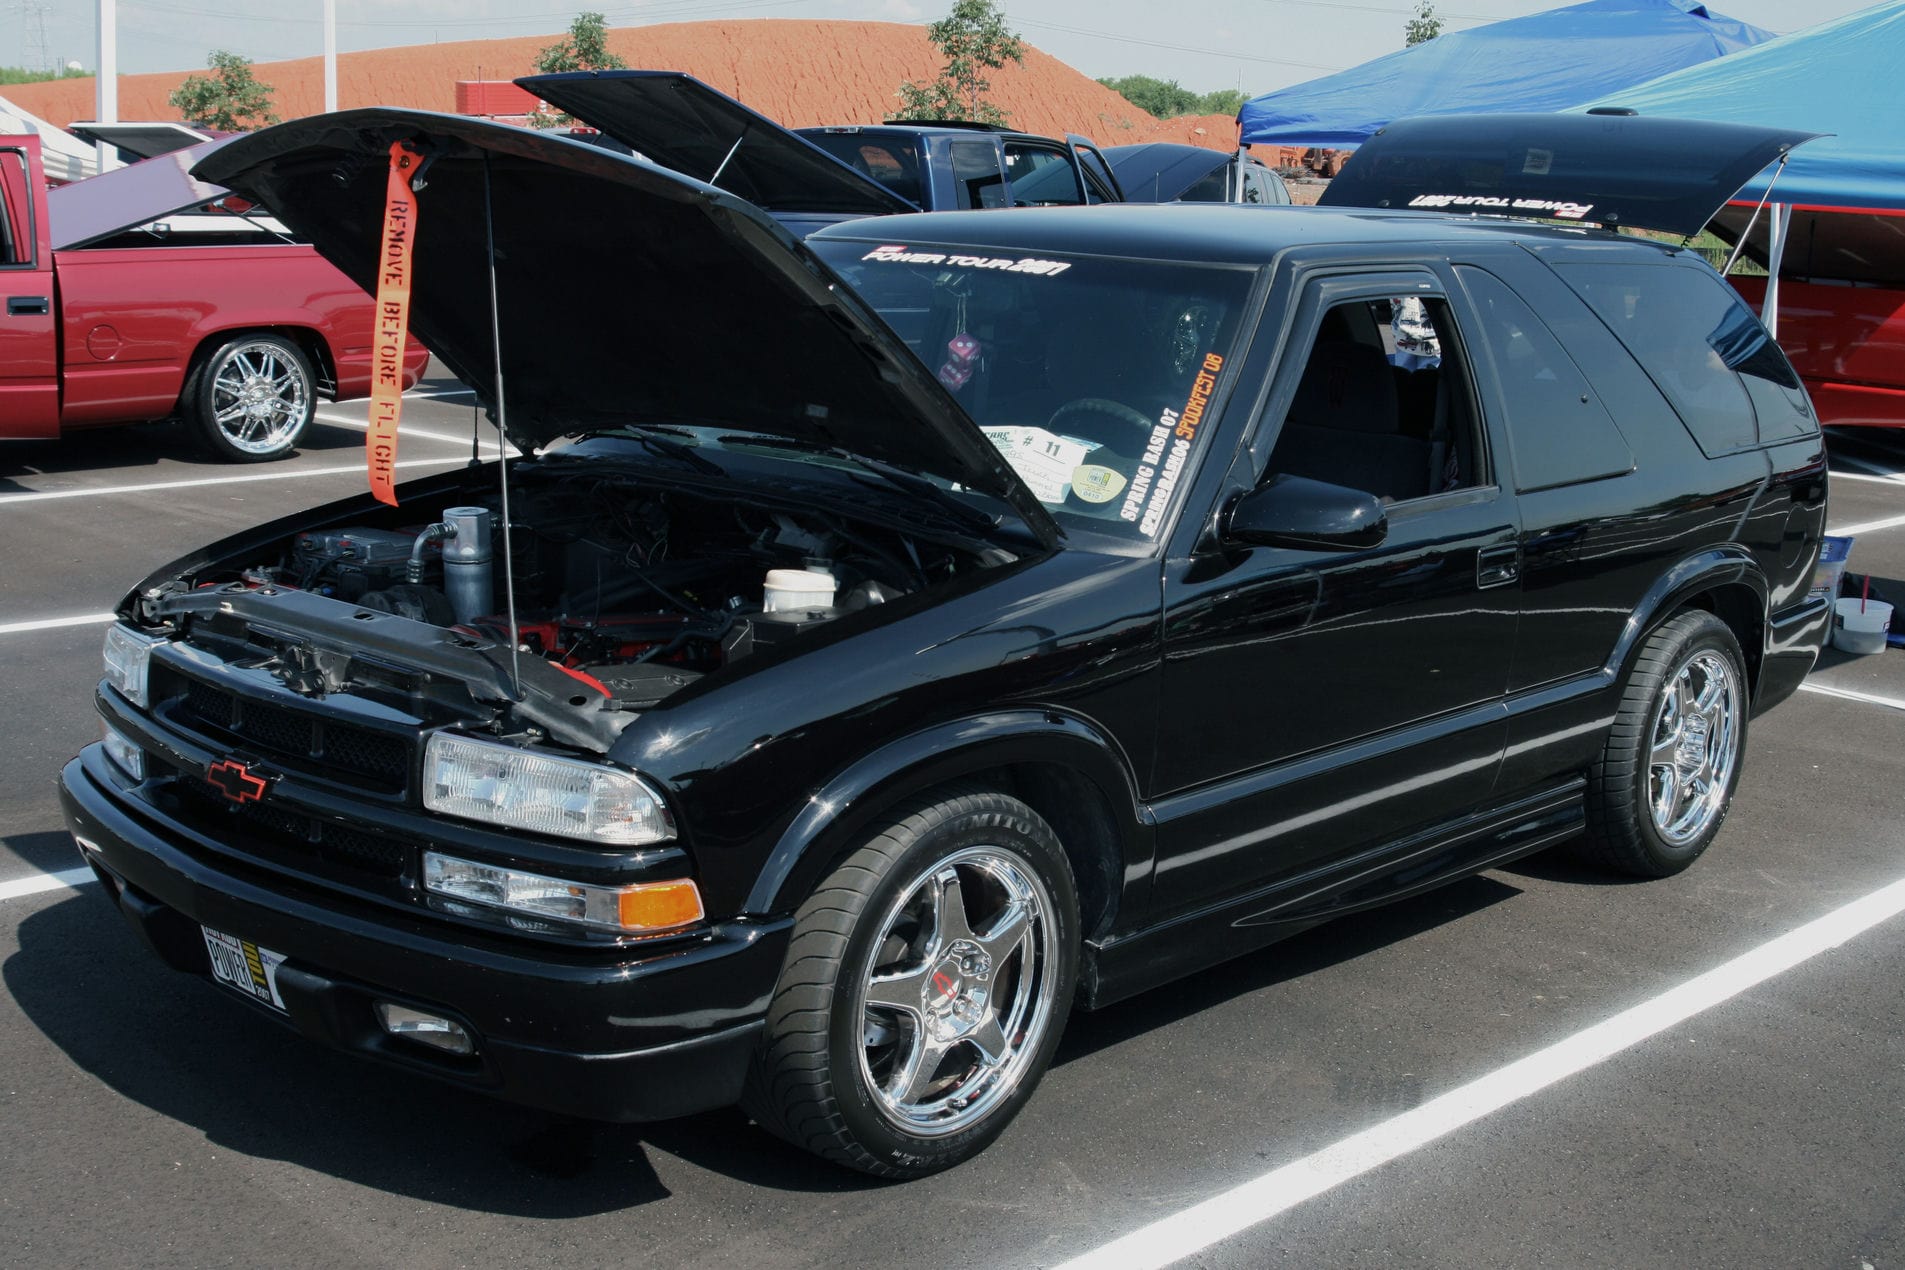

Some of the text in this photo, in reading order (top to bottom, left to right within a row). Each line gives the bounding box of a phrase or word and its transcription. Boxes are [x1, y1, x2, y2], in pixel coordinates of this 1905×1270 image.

[861, 251, 947, 264] POWER
[946, 255, 1013, 270] TOUR
[375, 200, 409, 486] REMOVE BEFORE FLIGHT
[1175, 370, 1216, 440] SPOOKFEST
[1045, 441, 1062, 457] 11
[1120, 407, 1179, 521] SPRING BASH 07
[207, 938, 255, 991] POWER
